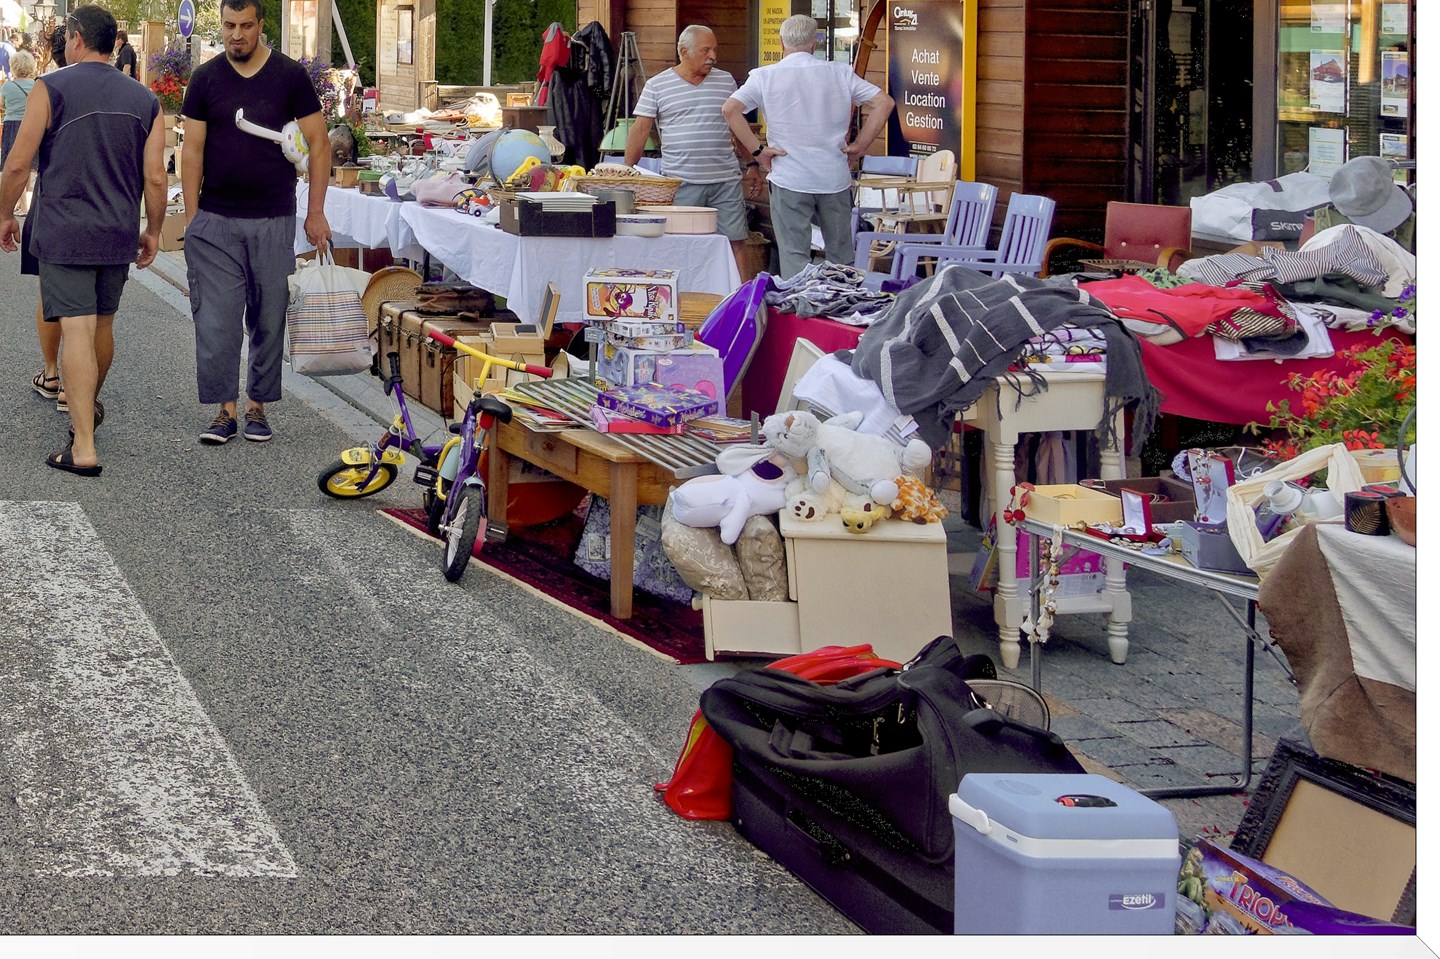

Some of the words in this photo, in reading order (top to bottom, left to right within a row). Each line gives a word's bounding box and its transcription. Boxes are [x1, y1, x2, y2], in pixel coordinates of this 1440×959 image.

[911, 48, 940, 64] Achat
[911, 69, 940, 86] Vente
[904, 90, 946, 108] Location
[906, 111, 943, 130] Gestion
[1228, 870, 1294, 928] TRIOP
